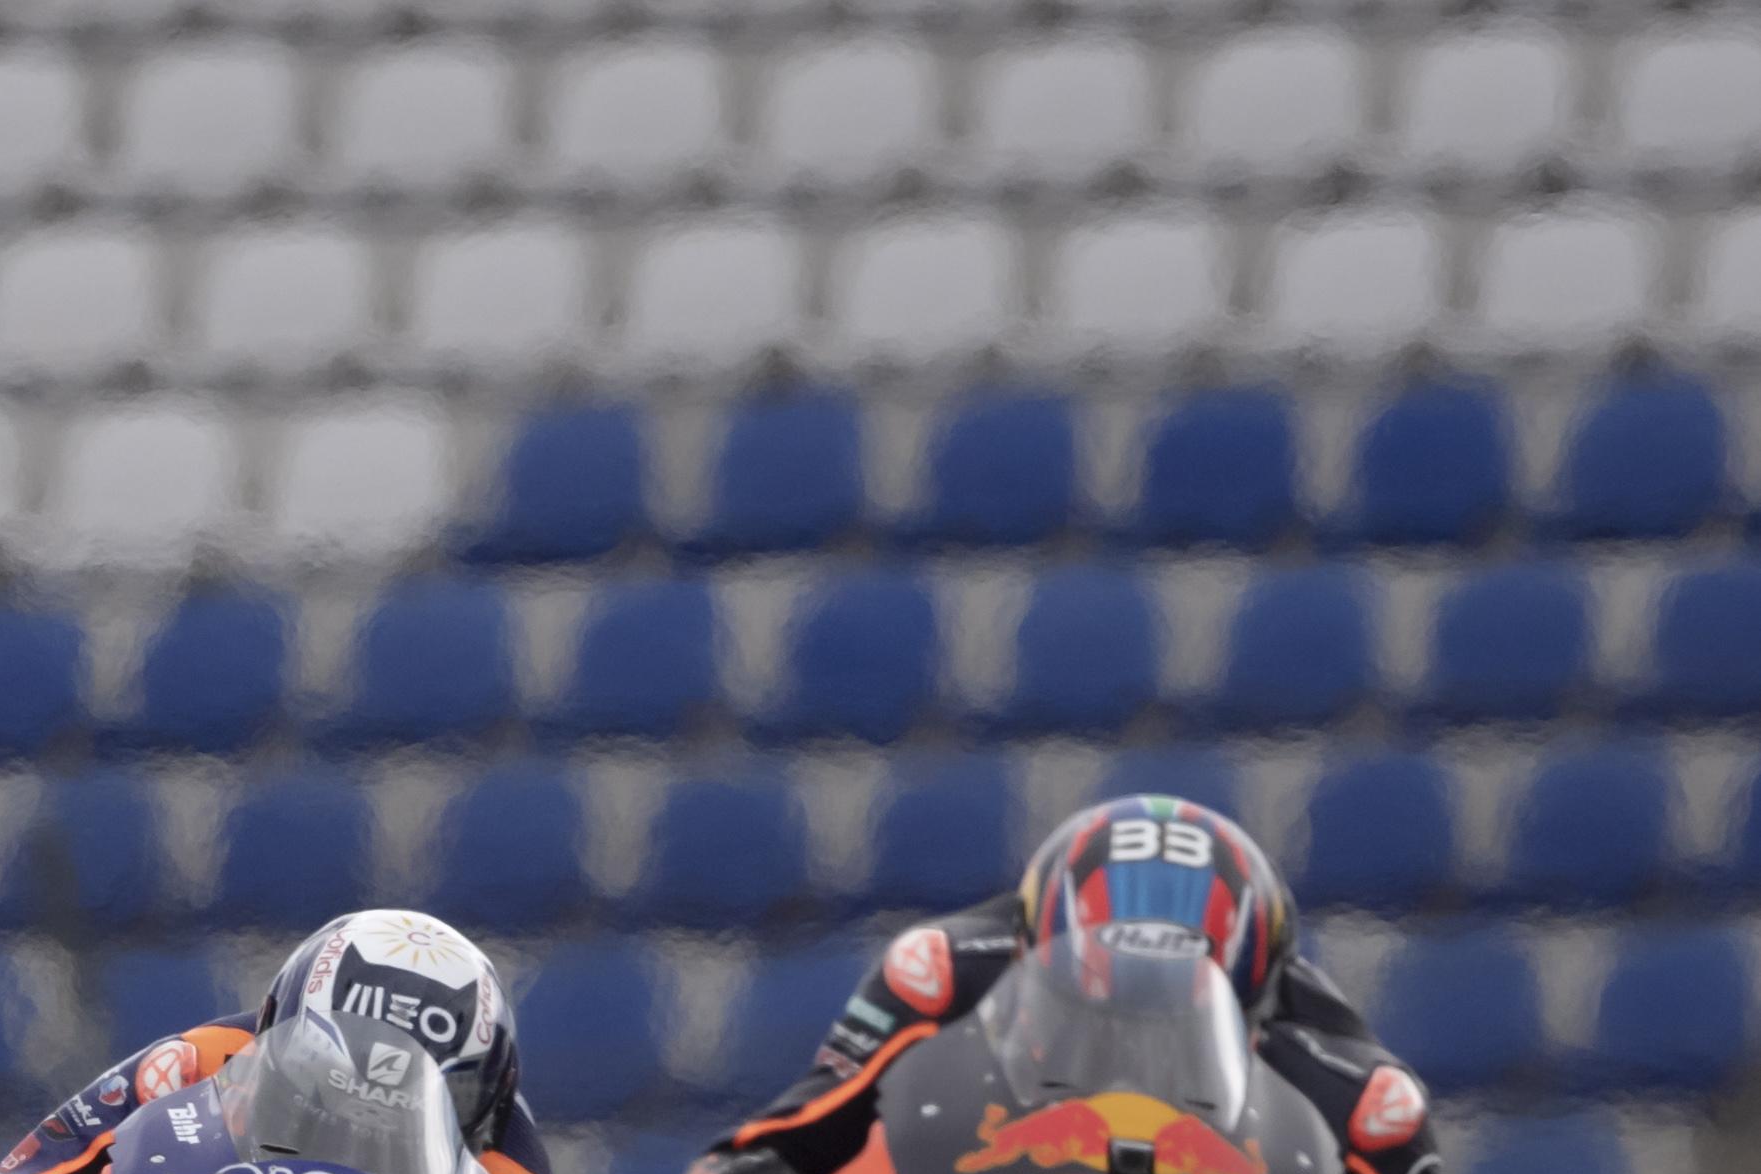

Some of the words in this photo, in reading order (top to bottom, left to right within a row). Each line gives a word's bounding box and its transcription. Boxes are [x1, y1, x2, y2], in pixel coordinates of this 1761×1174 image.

[1109, 820, 1213, 867] 33
[343, 983, 457, 1043] MEO
[328, 1069, 427, 1111] SHARK
[167, 1102, 203, 1144] Bihr
